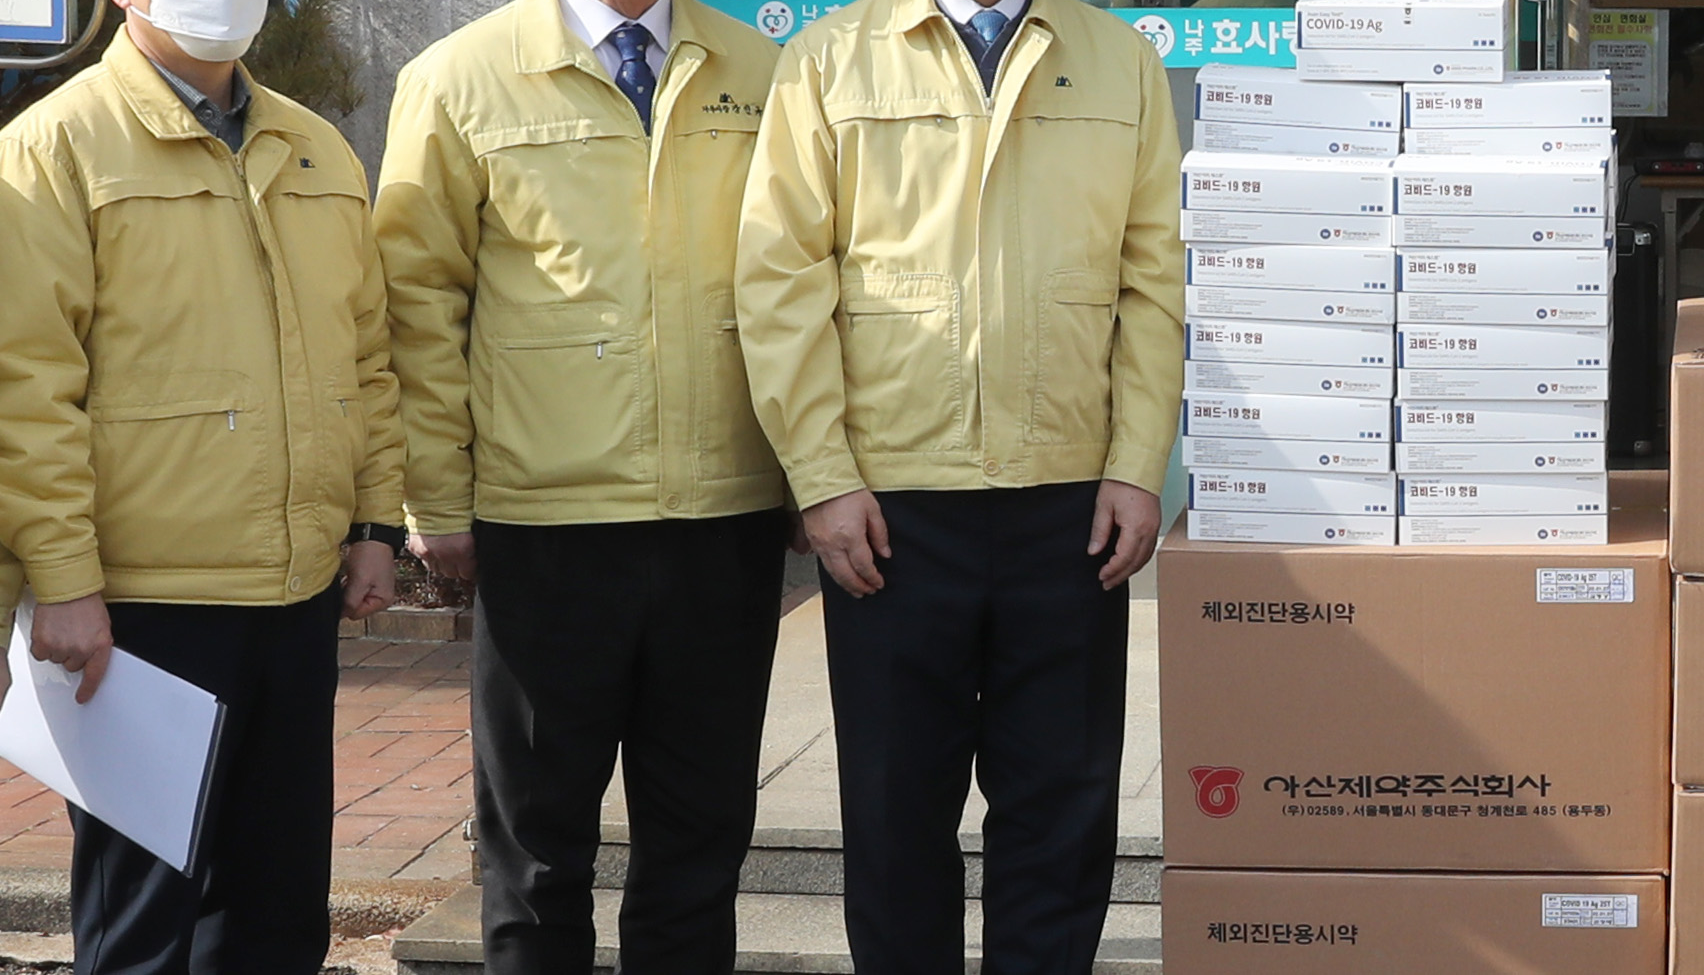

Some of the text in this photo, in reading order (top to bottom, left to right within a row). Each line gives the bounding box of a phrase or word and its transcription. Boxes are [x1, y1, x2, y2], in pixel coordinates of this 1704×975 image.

[1306, 18, 1383, 33] COVID-19 Ag
[1184, 19, 1204, 57] 나주
[1206, 90, 1273, 106] 코비드-19 항원
[1415, 97, 1483, 110] 코비드-19 항원
[1192, 179, 1261, 194] 코비드-19 항원
[1403, 183, 1473, 197] 코비드-19 항원
[1197, 255, 1265, 270] 코비드-19 항원
[1408, 262, 1477, 275] 코비드-19 항원
[1195, 330, 1263, 344] 코비드-19 항원
[1408, 337, 1478, 351] 코비드-19 항원
[1193, 405, 1261, 420] 코비드-19 항원
[1406, 411, 1475, 425] 코비드-19 항원
[1199, 480, 1267, 494] 코비드-19 항원
[1409, 485, 1479, 498] 코비드-19 항원
[1201, 600, 1356, 624] 체외진단용시약
[1263, 773, 1551, 799] 아산제약주식회사
[1353, 805, 1416, 817] 서울특별시
[1421, 805, 1472, 817] 동대문구
[1477, 805, 1528, 817] 청계천로
[1533, 805, 1557, 817] 485
[1562, 804, 1613, 818] (용두동)
[1207, 921, 1358, 945] 체외진단용시약
